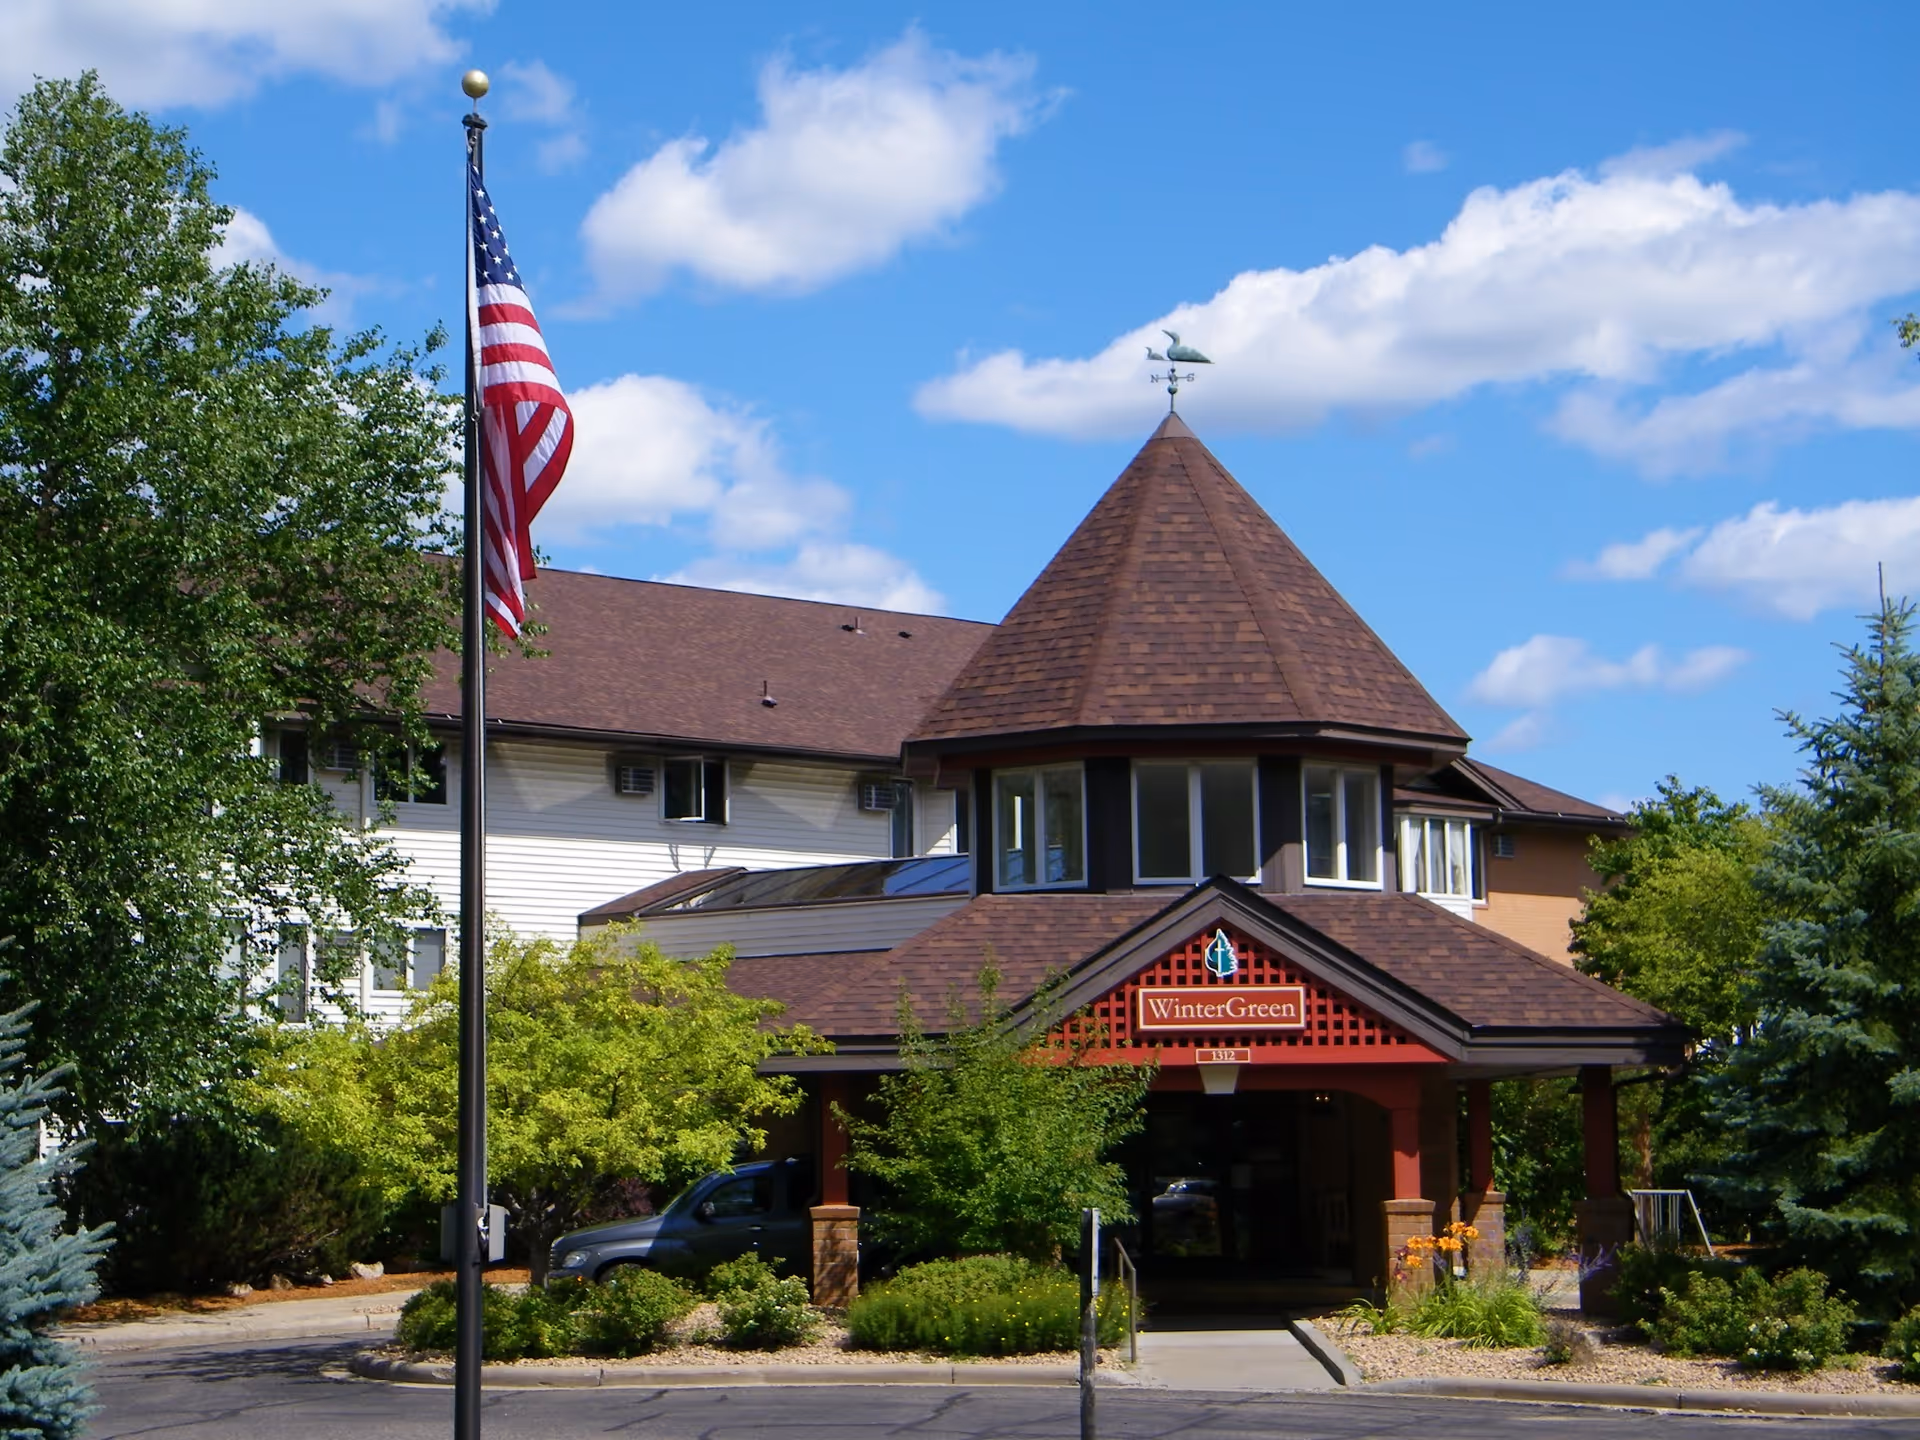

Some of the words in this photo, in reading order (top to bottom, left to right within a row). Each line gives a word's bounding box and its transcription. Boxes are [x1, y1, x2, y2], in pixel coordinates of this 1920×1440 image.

[1150, 374, 1159, 383] N
[1148, 997, 1296, 1019] WinterGreen
[1211, 1051, 1235, 1061] 1312
